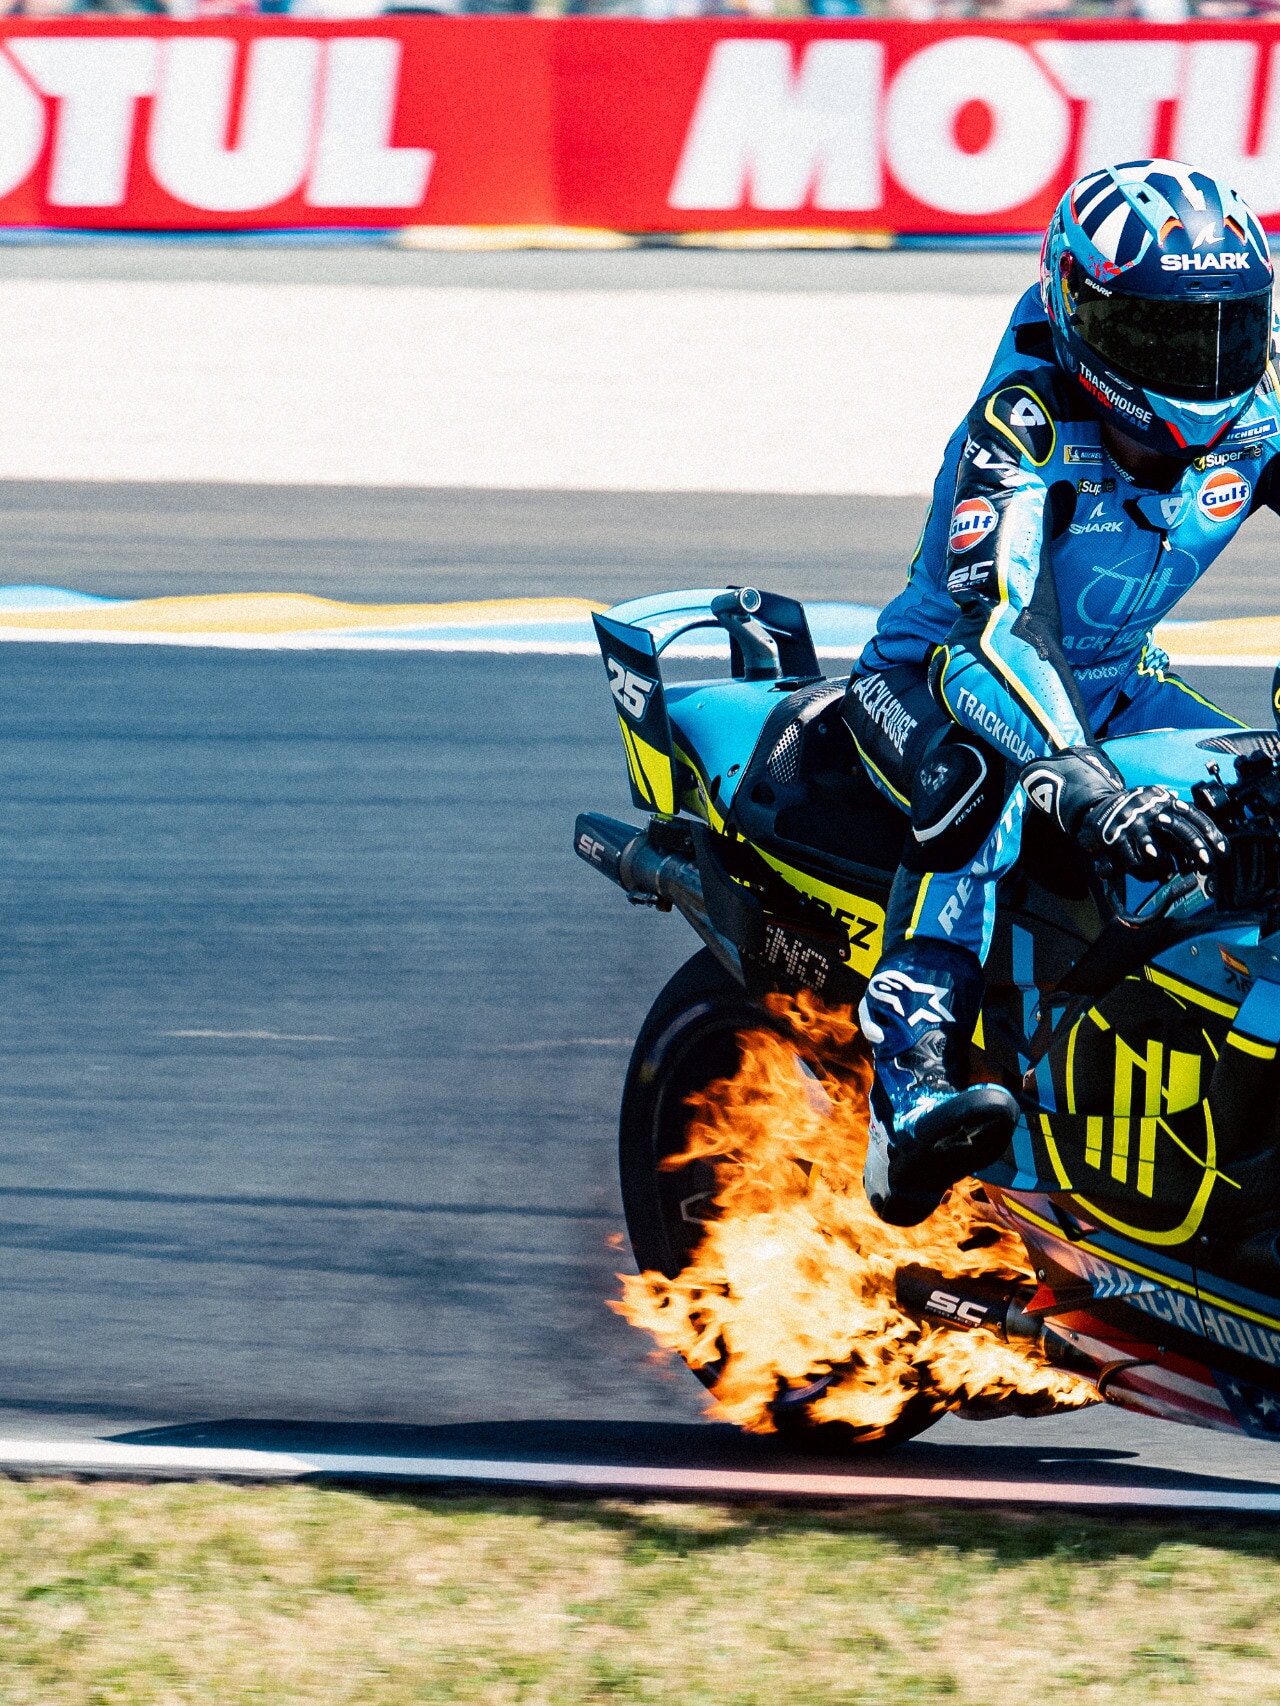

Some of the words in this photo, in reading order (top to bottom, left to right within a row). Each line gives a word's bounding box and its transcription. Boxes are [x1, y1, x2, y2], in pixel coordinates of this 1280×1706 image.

[0, 35, 436, 210] TUL
[1160, 252, 1250, 271] SHARK
[1084, 277, 1113, 298] SHARK
[1079, 361, 1154, 424] TRACKHOUSE
[1201, 484, 1248, 507] Gulf
[950, 515, 994, 536] Gulf
[1068, 521, 1124, 535] SHARK
[607, 656, 653, 720] 25
[955, 686, 1037, 763] TRACKHOUS
[578, 833, 605, 862] SC
[926, 1290, 989, 1324] SC
